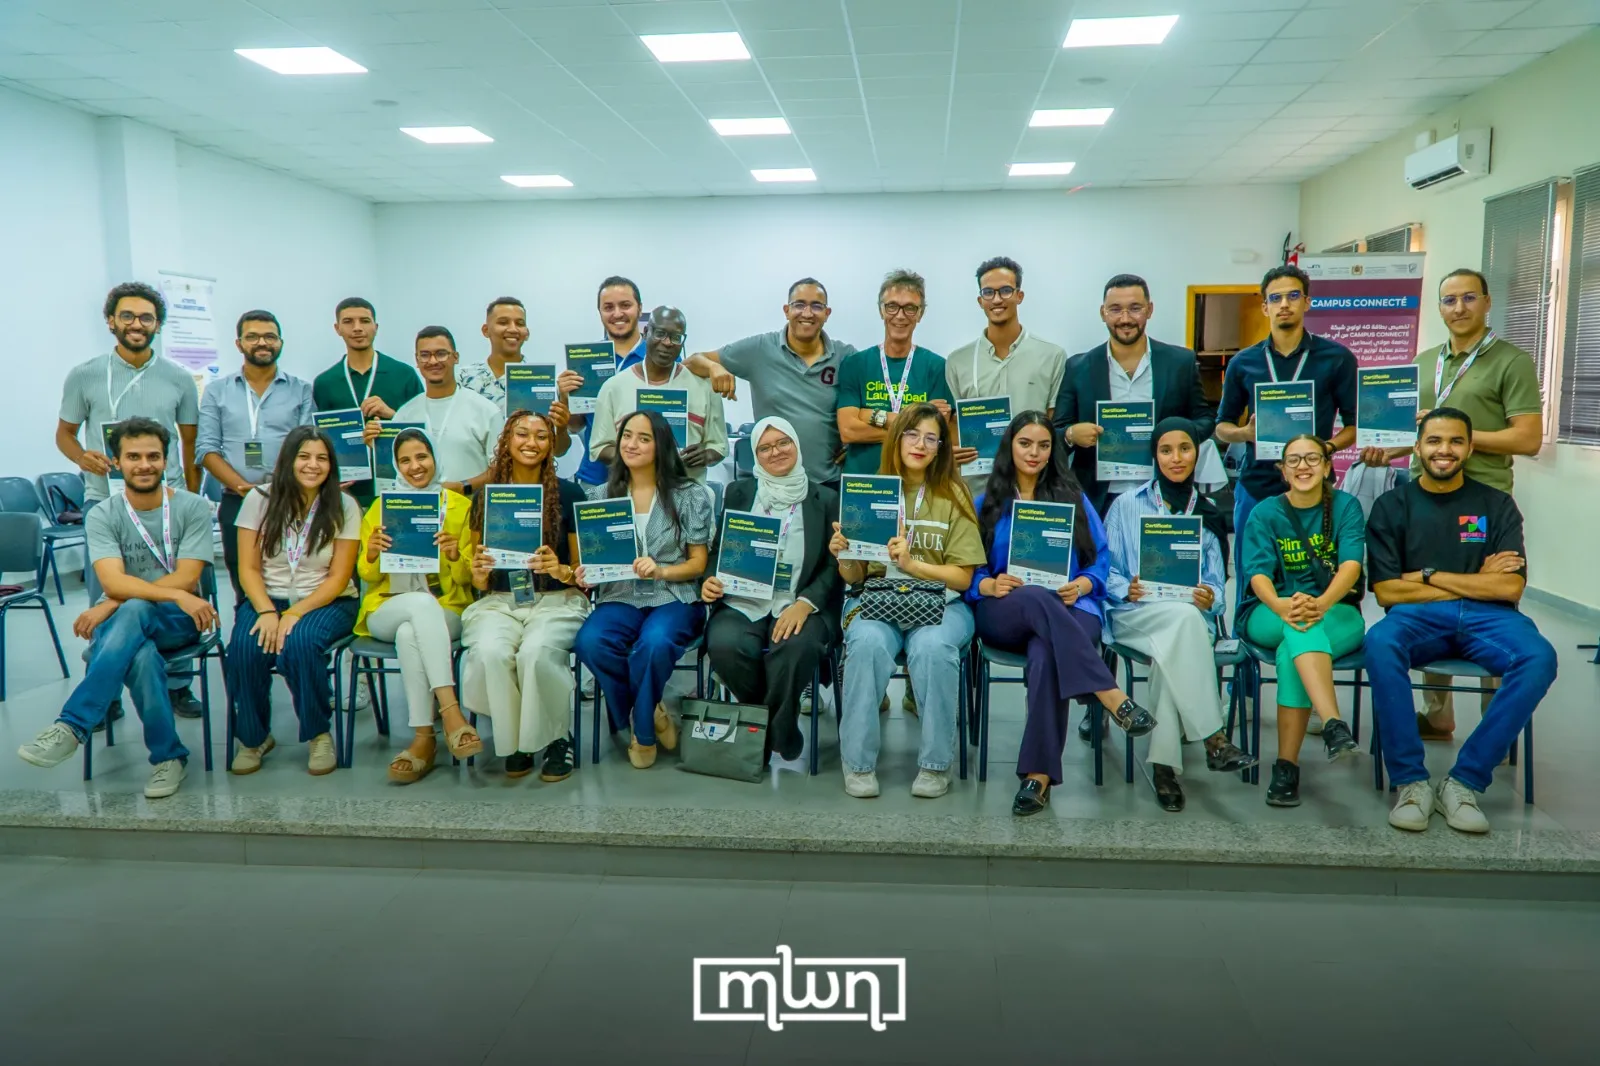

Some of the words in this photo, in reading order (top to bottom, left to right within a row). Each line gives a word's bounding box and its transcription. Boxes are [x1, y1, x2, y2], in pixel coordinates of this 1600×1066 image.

[1311, 299, 1351, 307] CAMPUS
[1353, 297, 1407, 307] CONNECTÉ
[821, 366, 835, 385] G
